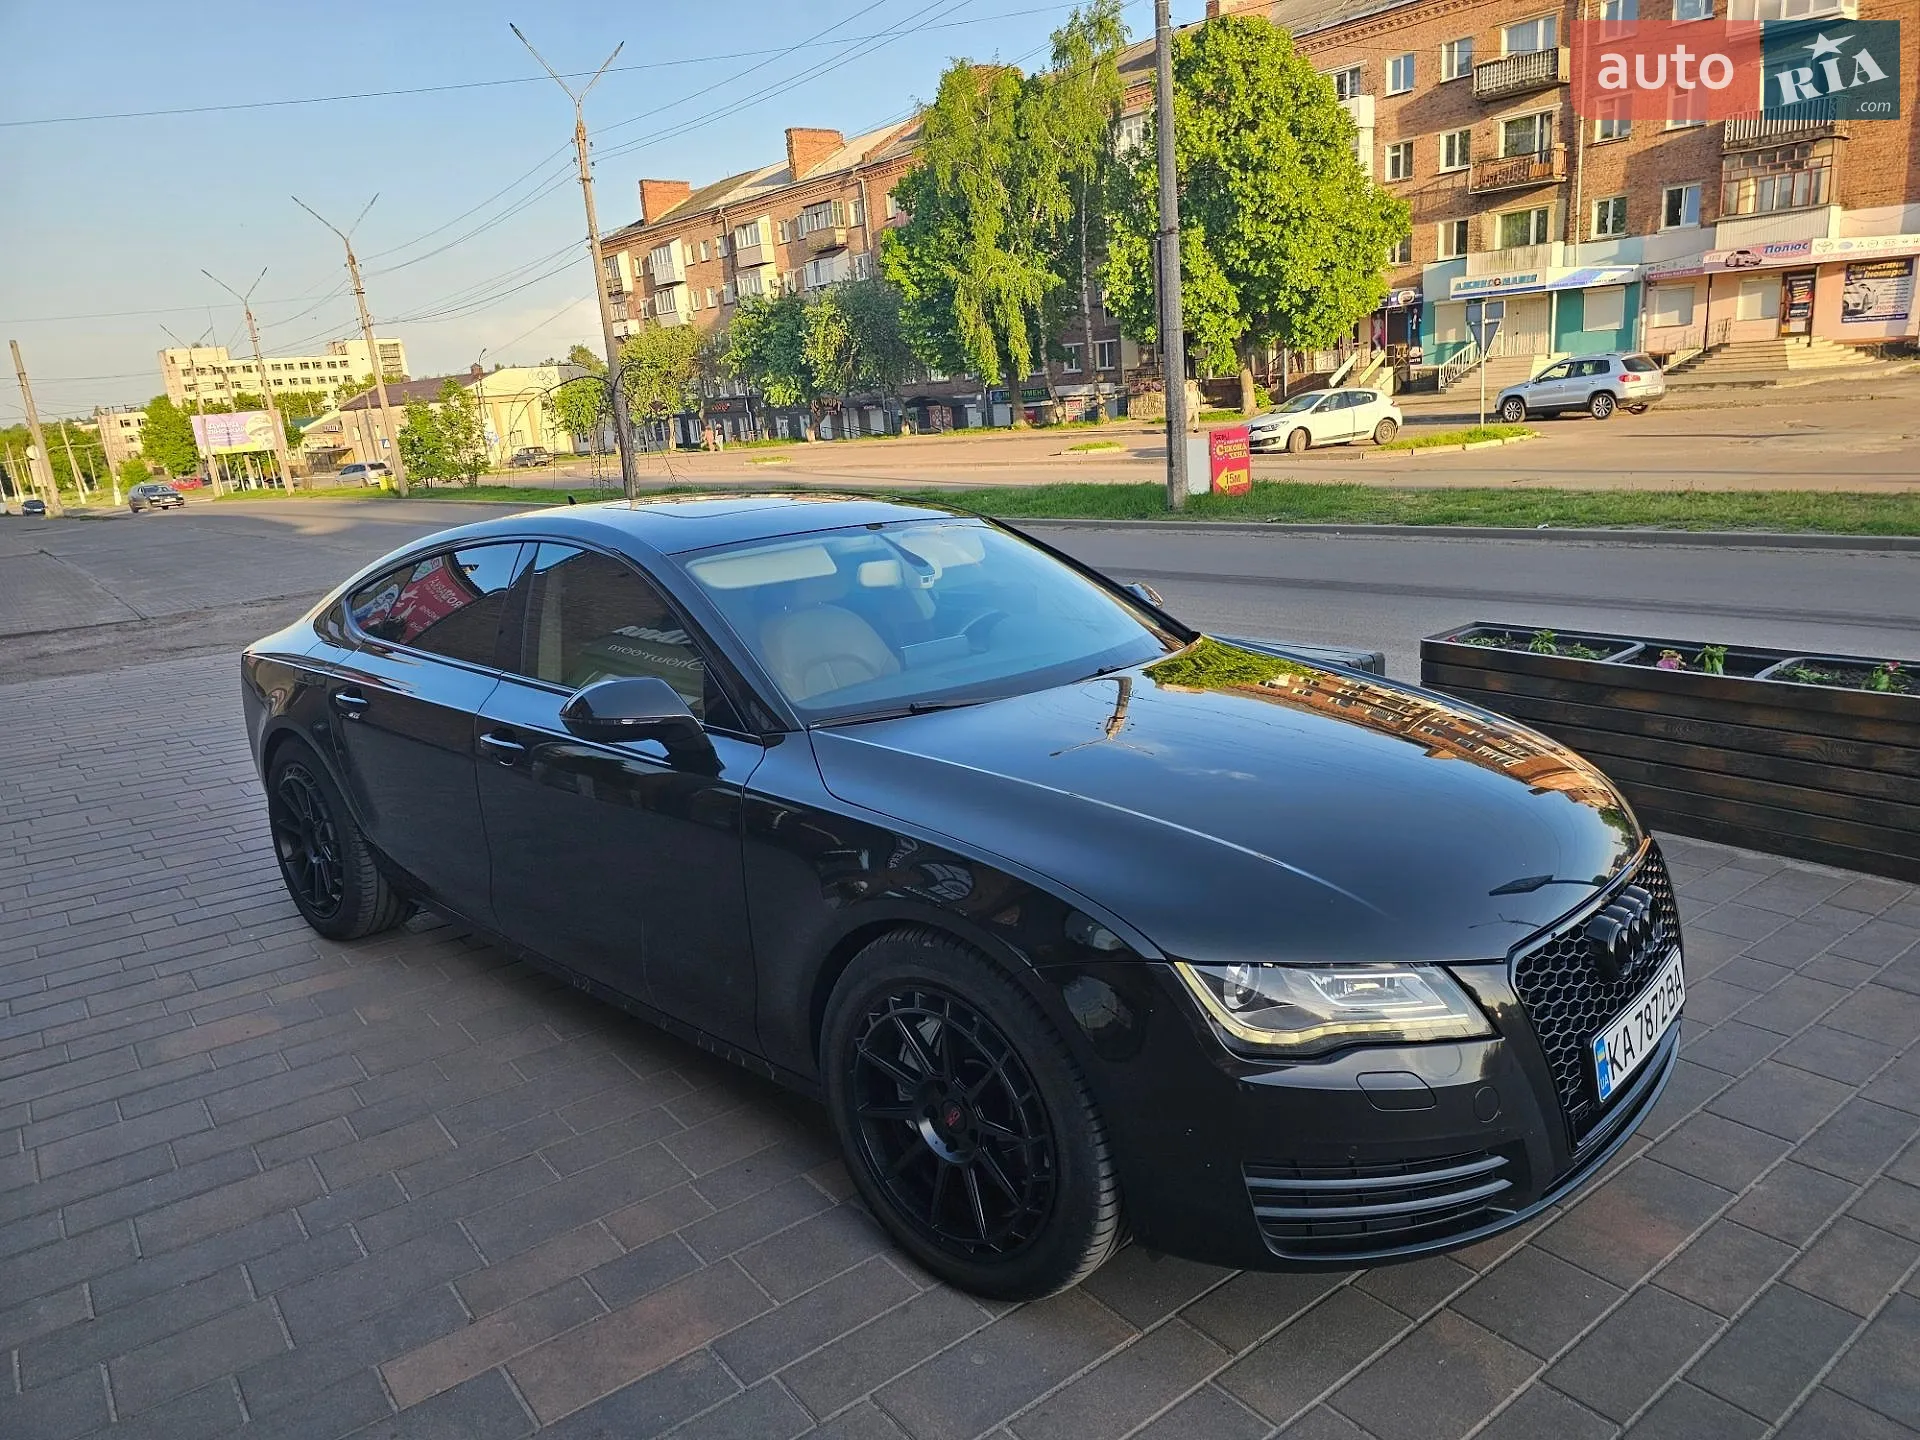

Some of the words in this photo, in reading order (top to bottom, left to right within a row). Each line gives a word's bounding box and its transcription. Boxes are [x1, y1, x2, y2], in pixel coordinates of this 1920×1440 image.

[1764, 242, 1809, 254] Полюс
[1607, 1024, 1636, 1081] KA
[1635, 985, 1668, 1053] 7872
